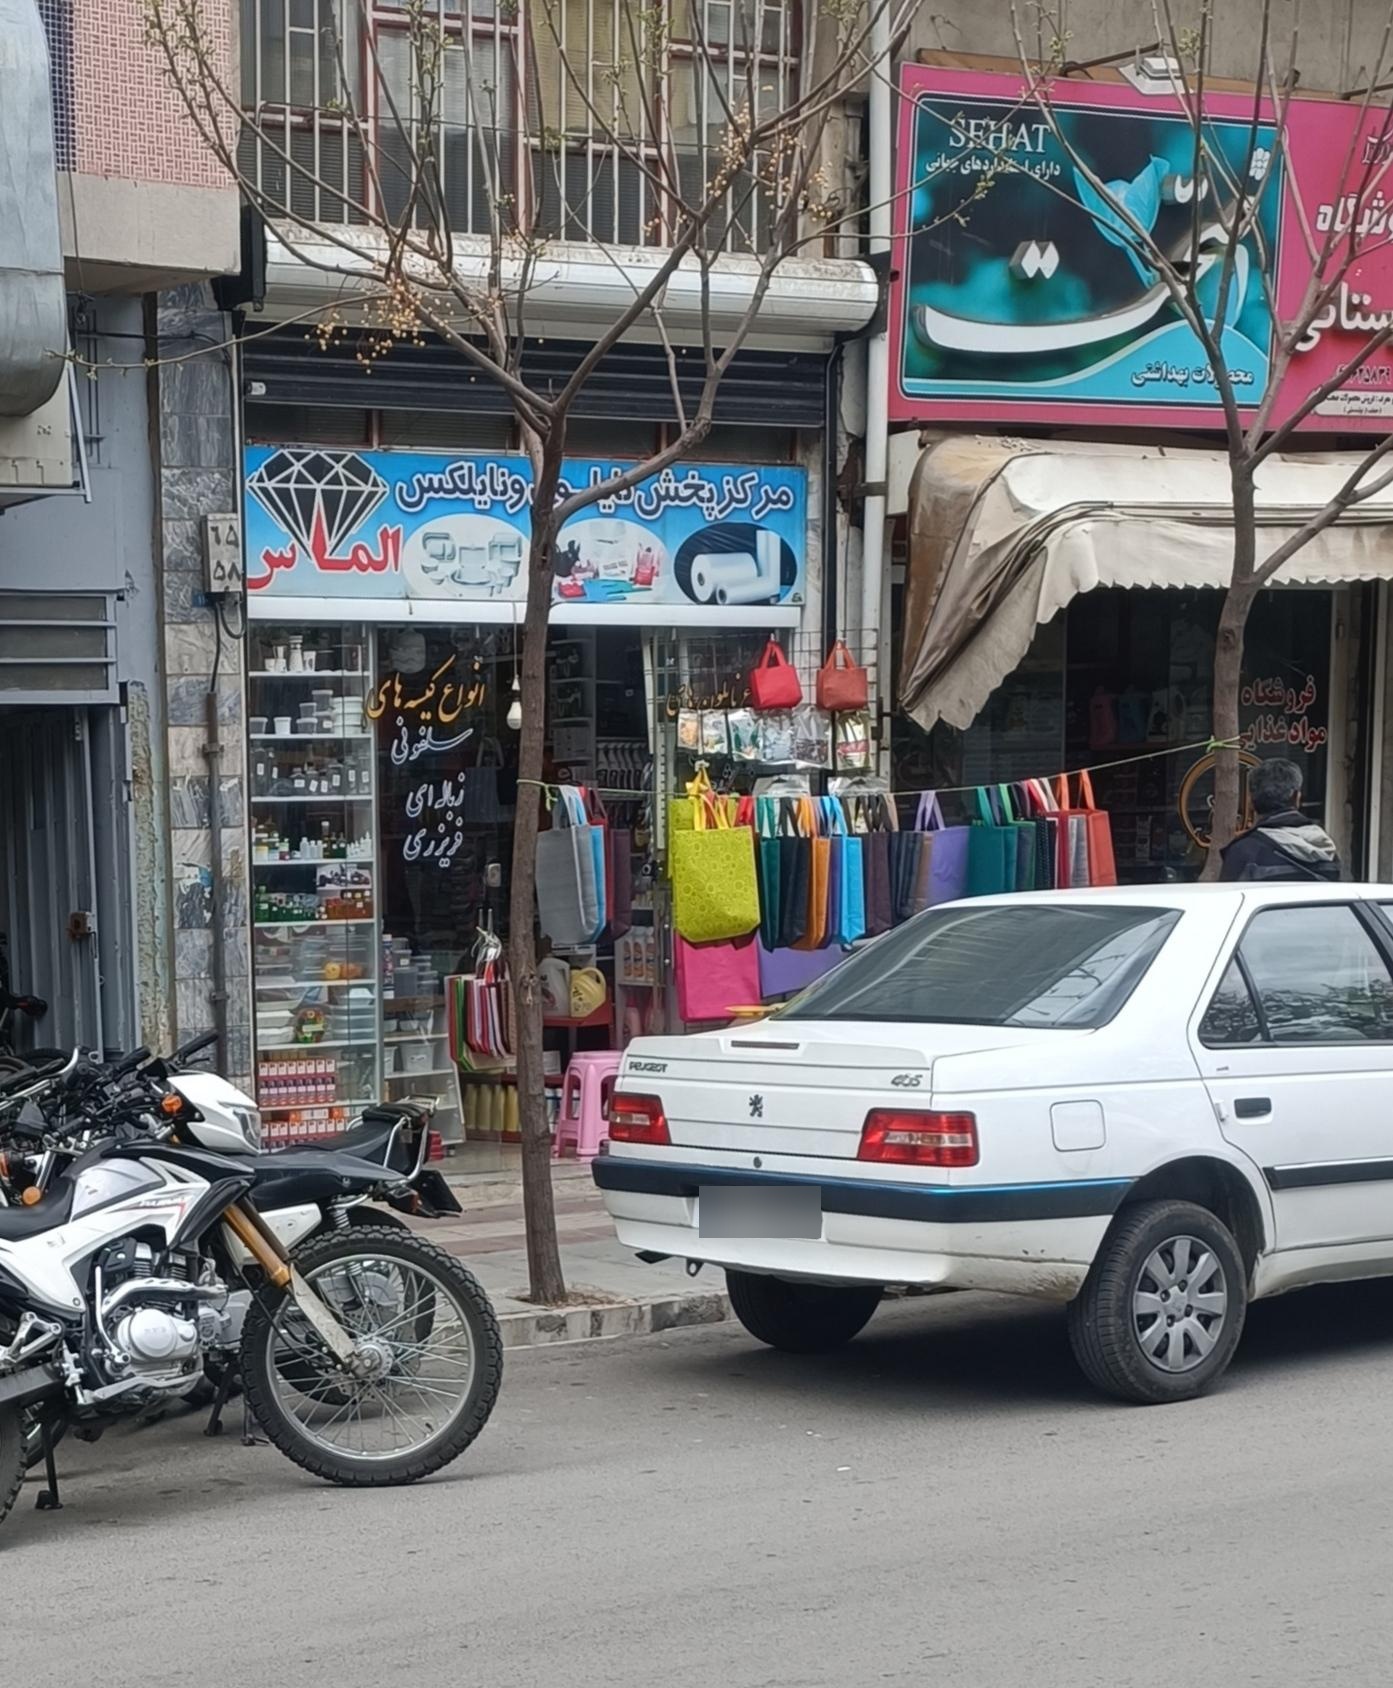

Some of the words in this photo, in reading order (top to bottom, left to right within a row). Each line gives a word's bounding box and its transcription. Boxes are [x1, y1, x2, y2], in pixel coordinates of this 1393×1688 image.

[950, 118, 1050, 153] SEHAT
[1030, 159, 1061, 181] دارای
[1131, 361, 1190, 387] بهداشتی
[1191, 363, 1254, 391] محصلات
[528, 466, 634, 513] نایلو
[634, 468, 716, 520] پخش
[716, 472, 794, 519] مرکز
[246, 500, 403, 590] الماس
[367, 671, 401, 718] های
[404, 654, 457, 720] کیسه
[438, 660, 485, 722] انواع
[1240, 674, 1317, 714] فروشگاه
[391, 716, 474, 765] سلفونی
[1287, 715, 1328, 752] مواد
[403, 816, 463, 868] فریزری
[629, 1060, 668, 1073] PEUGEOT
[891, 1073, 923, 1087] 405
